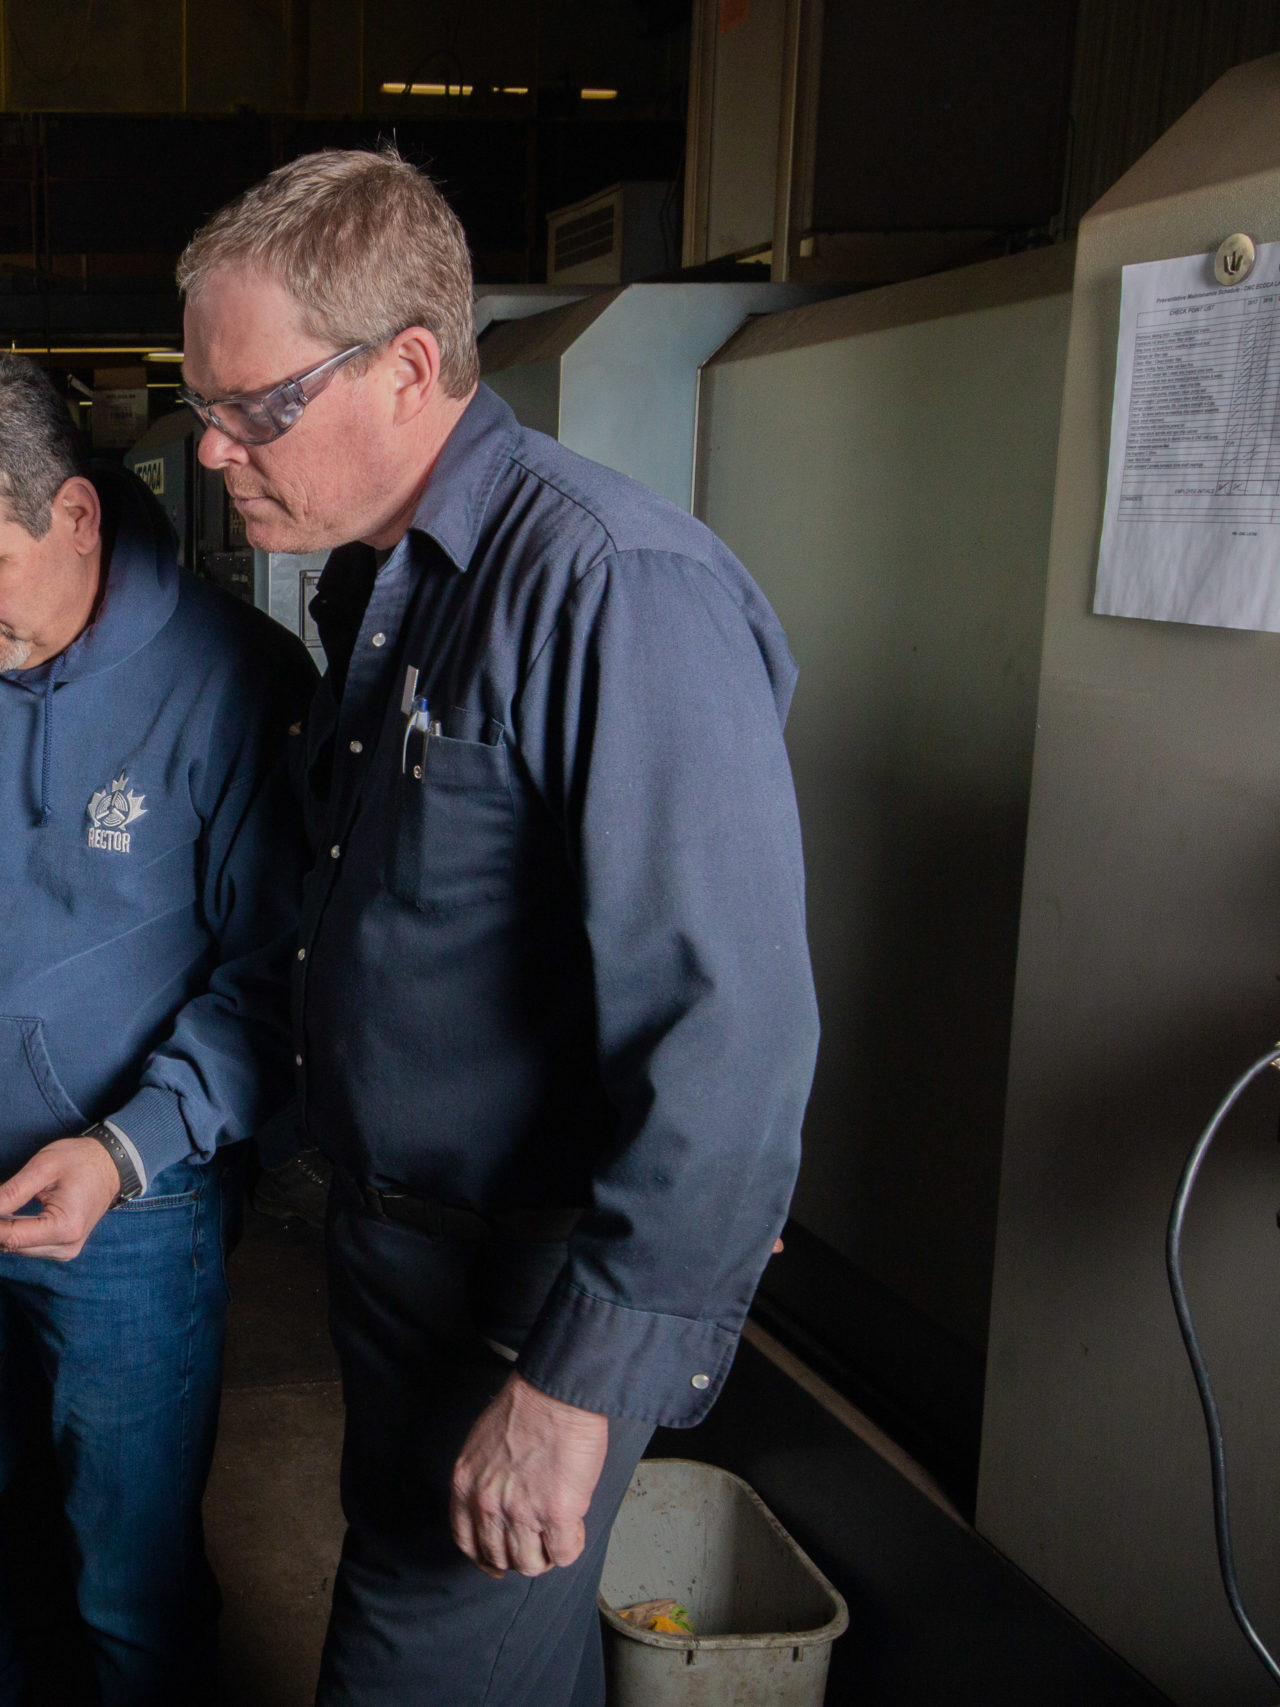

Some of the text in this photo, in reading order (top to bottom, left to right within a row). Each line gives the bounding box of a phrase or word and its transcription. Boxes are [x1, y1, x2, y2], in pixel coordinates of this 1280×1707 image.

[1169, 304, 1215, 316] CHECK POINT LIST
[88, 827, 131, 853] RECTOR
